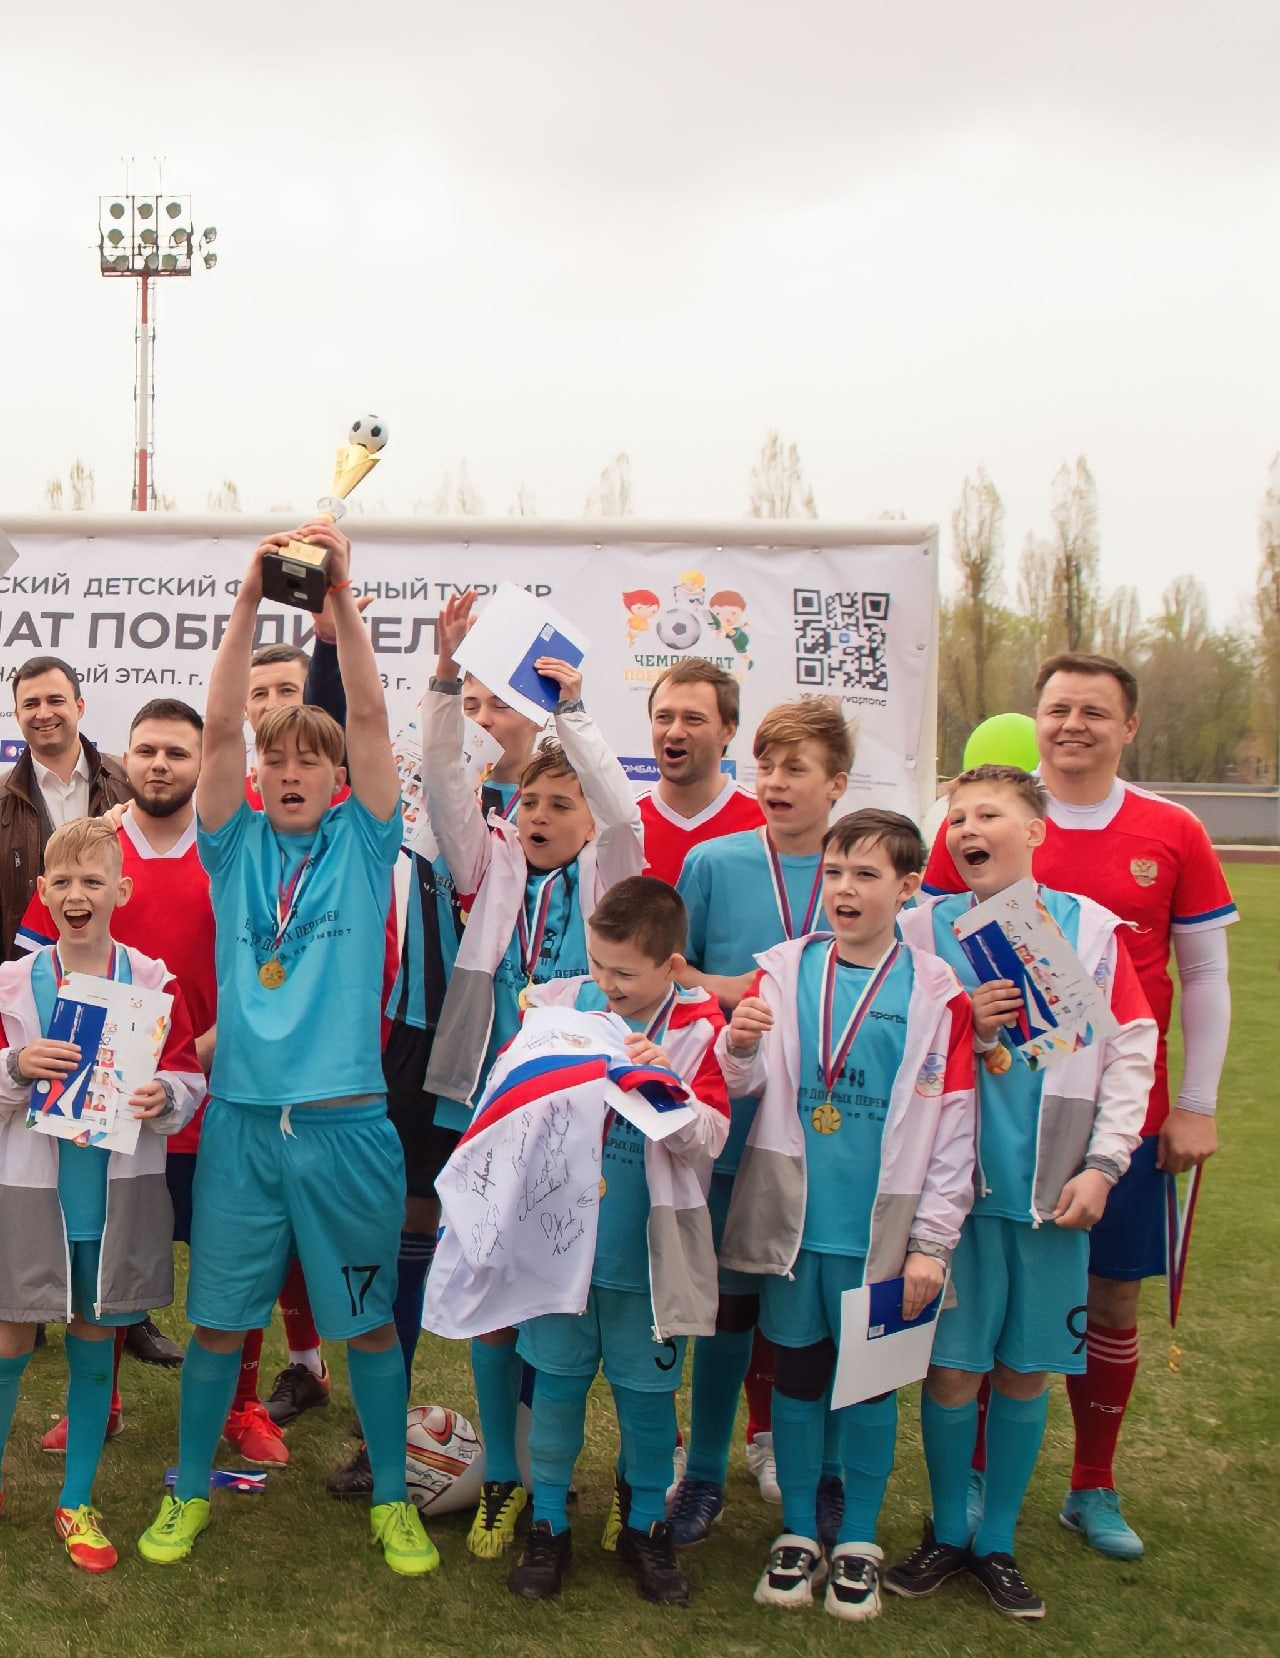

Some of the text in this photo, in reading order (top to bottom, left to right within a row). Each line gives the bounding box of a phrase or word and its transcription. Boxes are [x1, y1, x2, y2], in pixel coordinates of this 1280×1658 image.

[84, 575, 215, 599] ДЕТСКИЙ
[115, 667, 182, 685] ЭТАП.
[189, 673, 203, 686] г.
[396, 676, 411, 690] г.
[341, 1265, 381, 1317] 17
